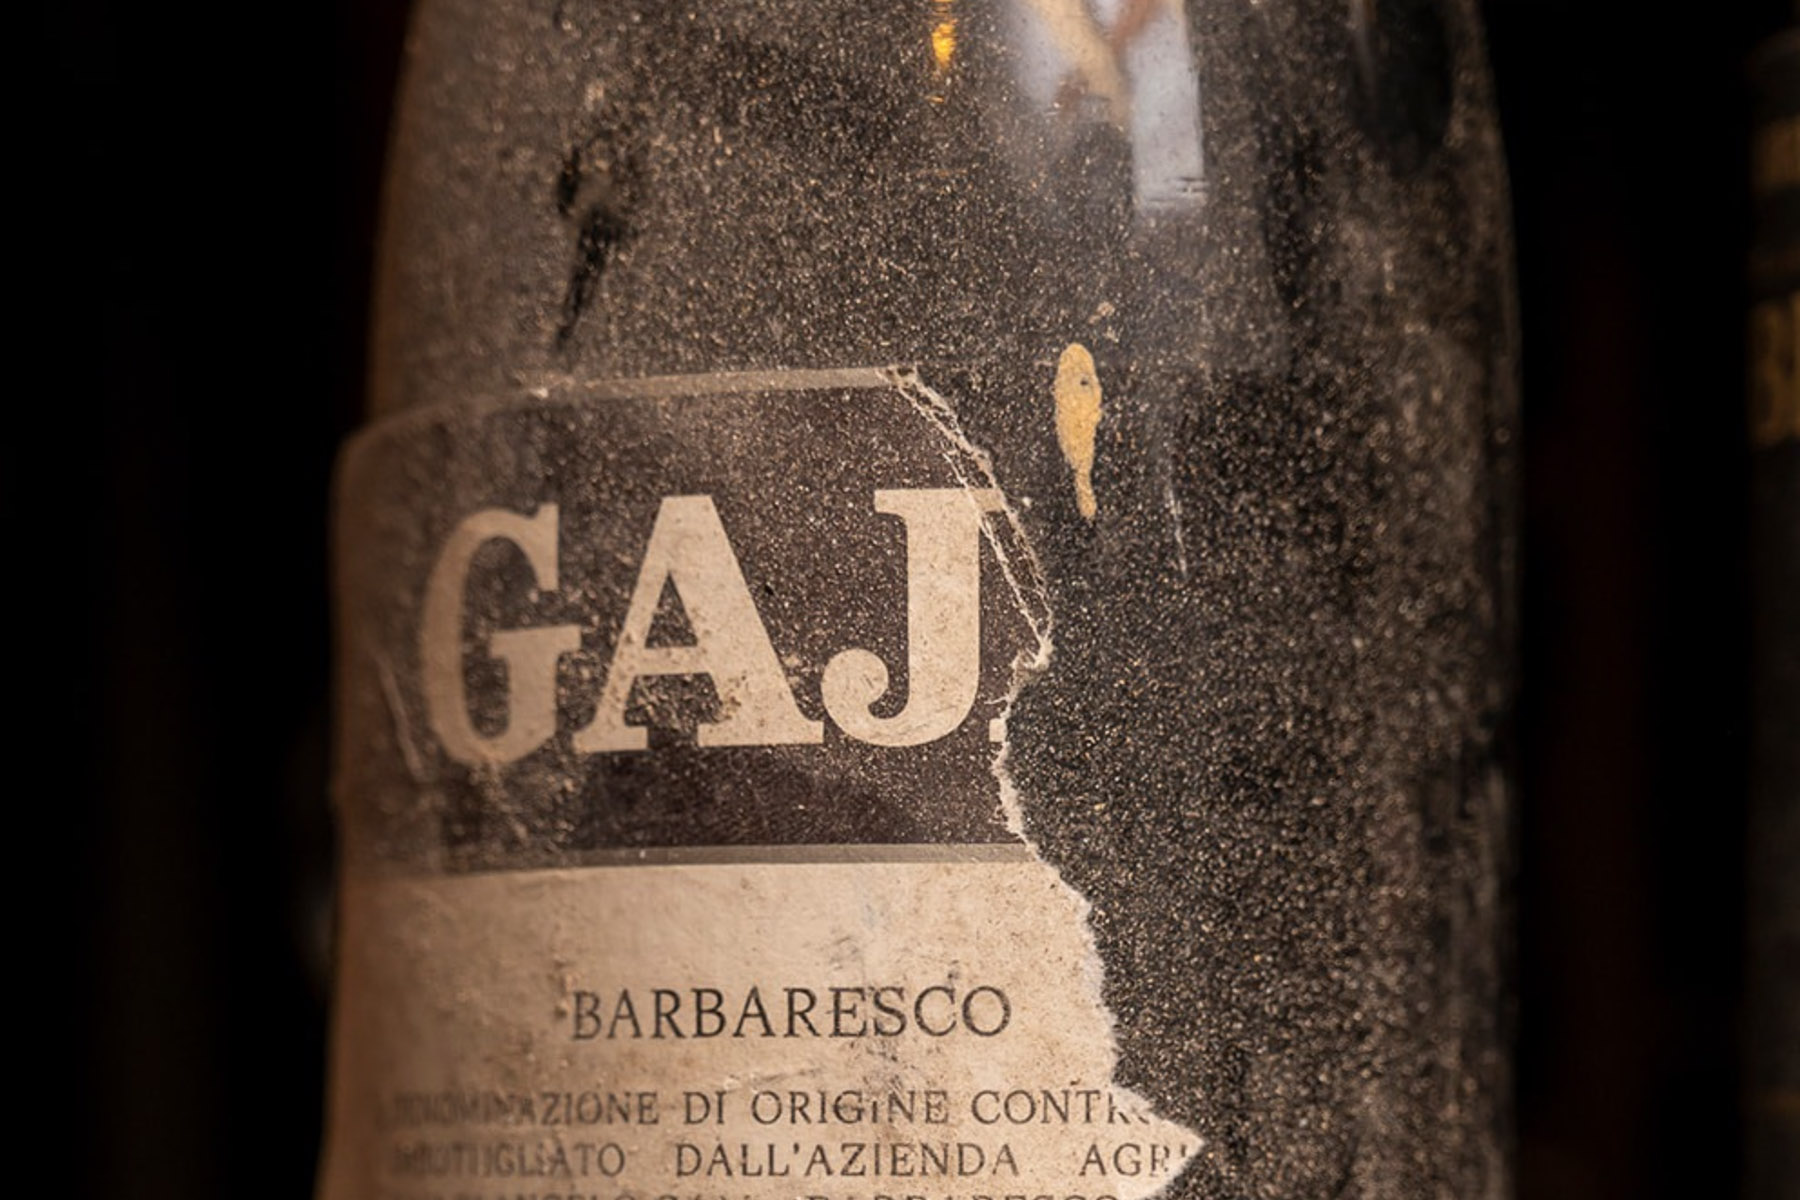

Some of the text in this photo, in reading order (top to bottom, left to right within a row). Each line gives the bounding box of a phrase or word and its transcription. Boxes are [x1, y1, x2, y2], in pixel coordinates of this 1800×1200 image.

[418, 487, 1003, 768] GAJ
[570, 985, 1013, 1040] BARBARESCO
[682, 1090, 726, 1125] DI
[751, 1089, 950, 1125] ORIGINE
[970, 1088, 1151, 1125] CONTR
[675, 1142, 1020, 1178] DALL'AZIENDA
